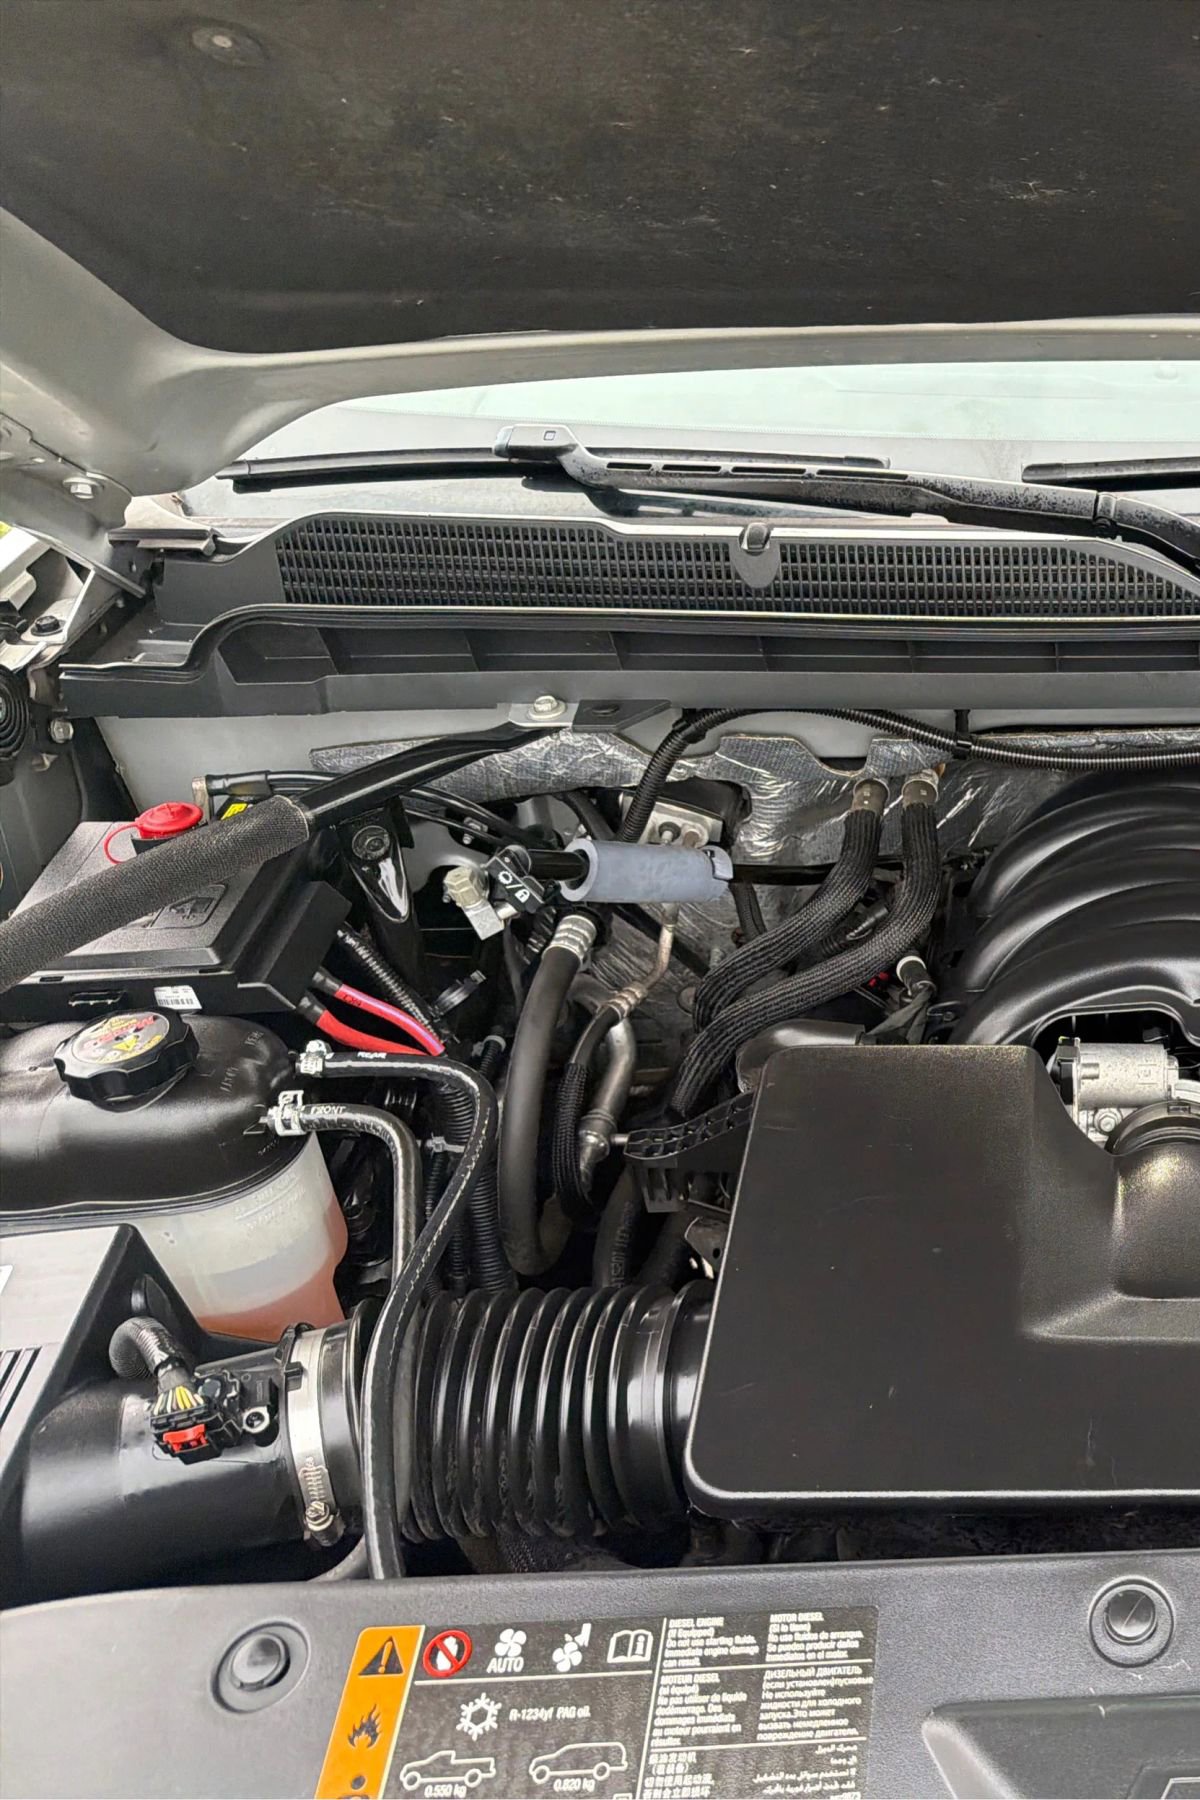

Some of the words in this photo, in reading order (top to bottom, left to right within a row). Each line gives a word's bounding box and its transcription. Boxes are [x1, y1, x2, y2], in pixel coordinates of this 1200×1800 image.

[311, 1106, 346, 1114] FRONT
[486, 1657, 524, 1673] AUTO
[816, 1666, 862, 1678] ДВИГАТЕЛЬ
[557, 1707, 575, 1719] PAG
[454, 1784, 468, 1798] kg
[582, 1778, 595, 1792] kg
